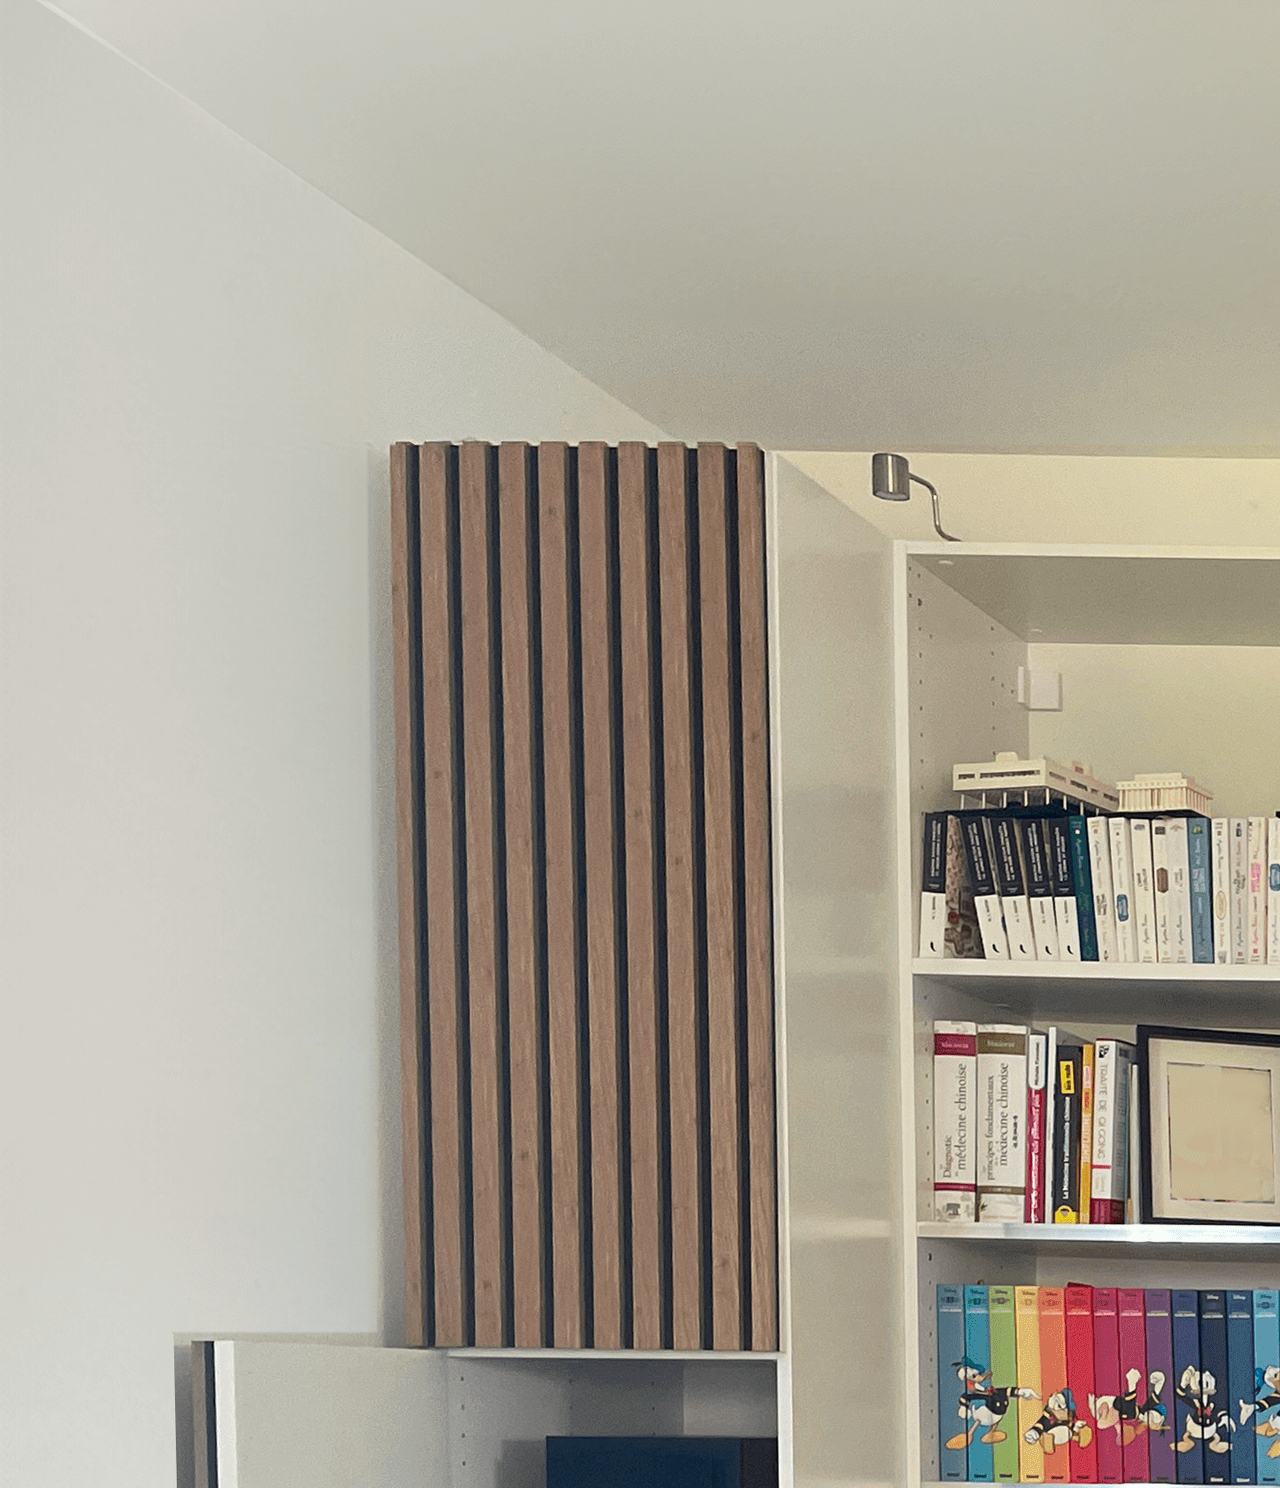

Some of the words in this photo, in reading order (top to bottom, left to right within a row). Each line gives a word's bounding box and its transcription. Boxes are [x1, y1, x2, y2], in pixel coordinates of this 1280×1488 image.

[954, 1064, 967, 1111] chinoise
[985, 1075, 994, 1138] fondamentaux
[998, 1062, 1009, 1109] chinoise
[955, 1114, 967, 1170] médecine
[998, 1111, 1009, 1166] médecine
